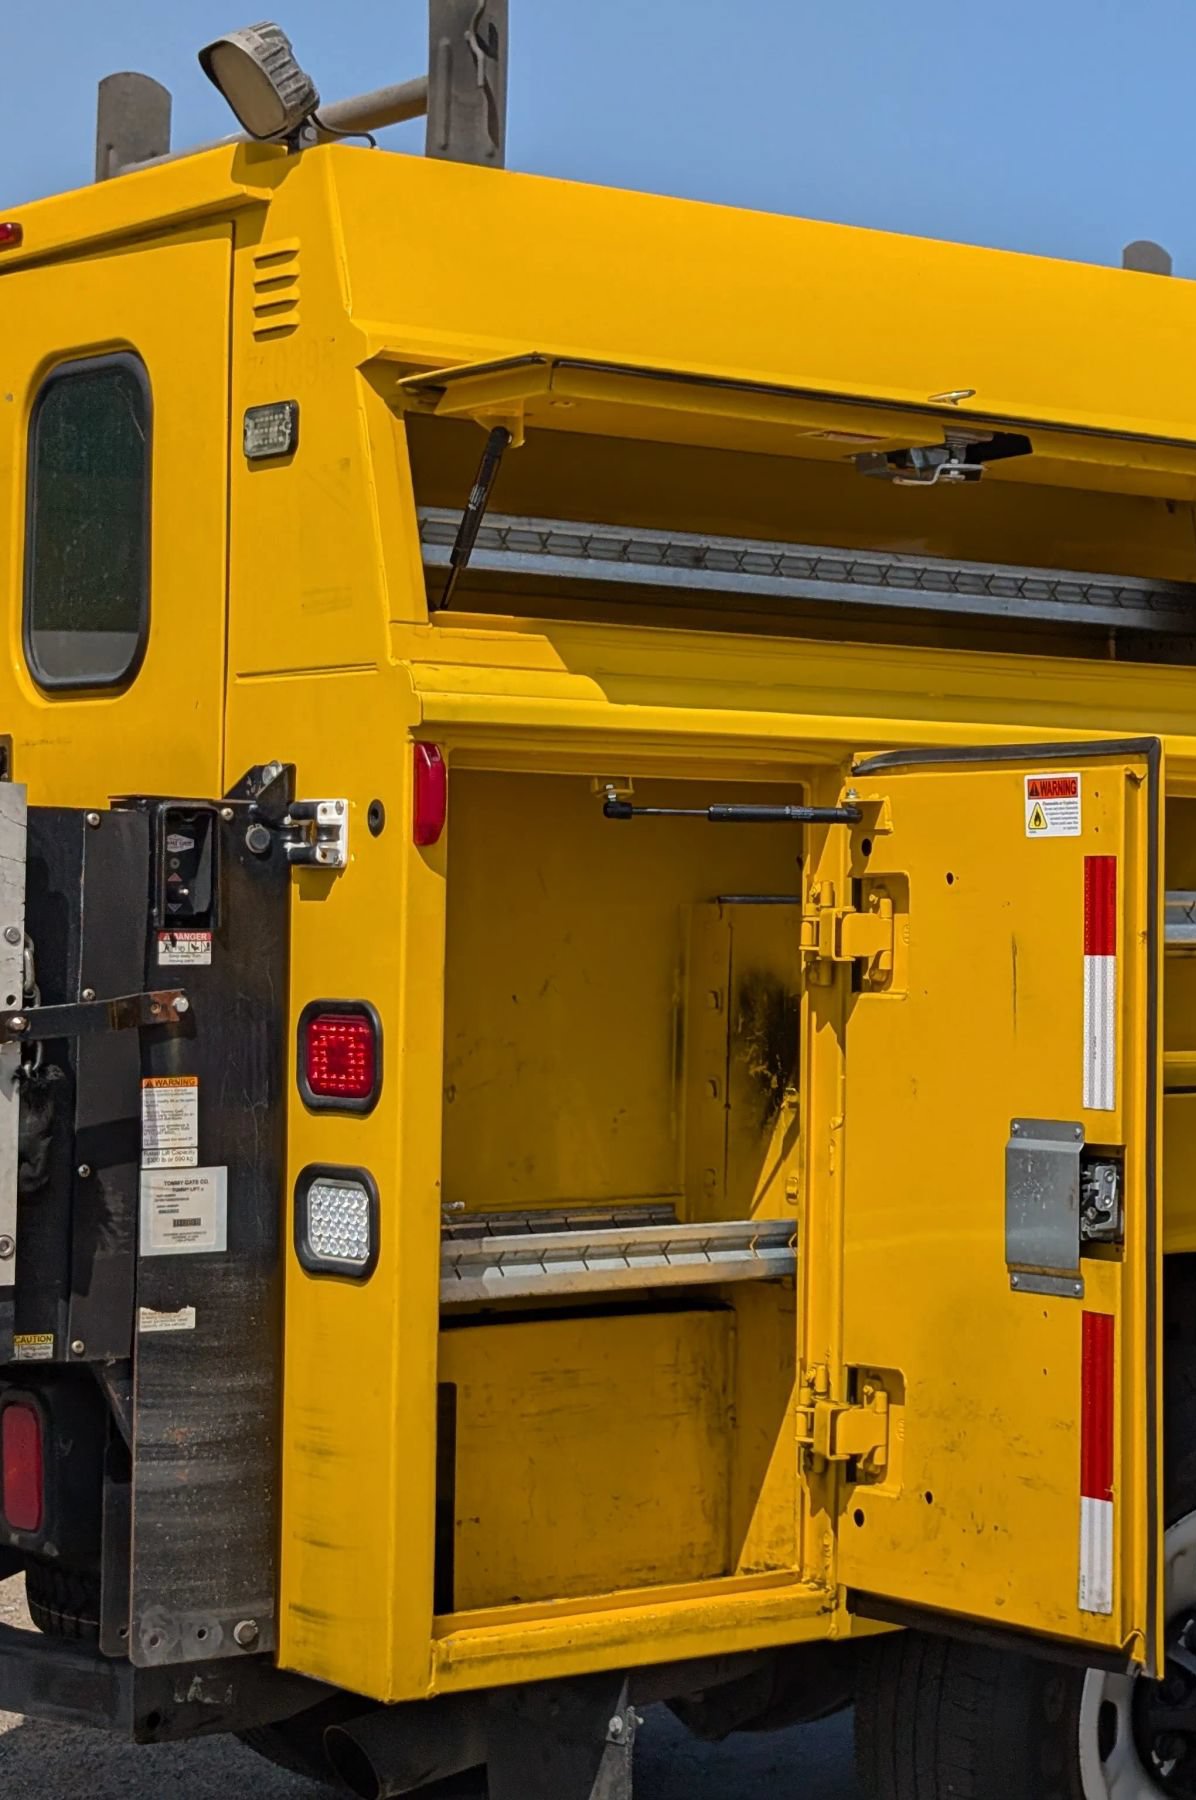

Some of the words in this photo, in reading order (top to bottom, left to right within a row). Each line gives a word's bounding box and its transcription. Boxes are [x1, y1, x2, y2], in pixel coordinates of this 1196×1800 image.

[1040, 780, 1077, 797] WARNING
[155, 1078, 196, 1087] WARNING
[15, 1335, 52, 1344] CAUTION
